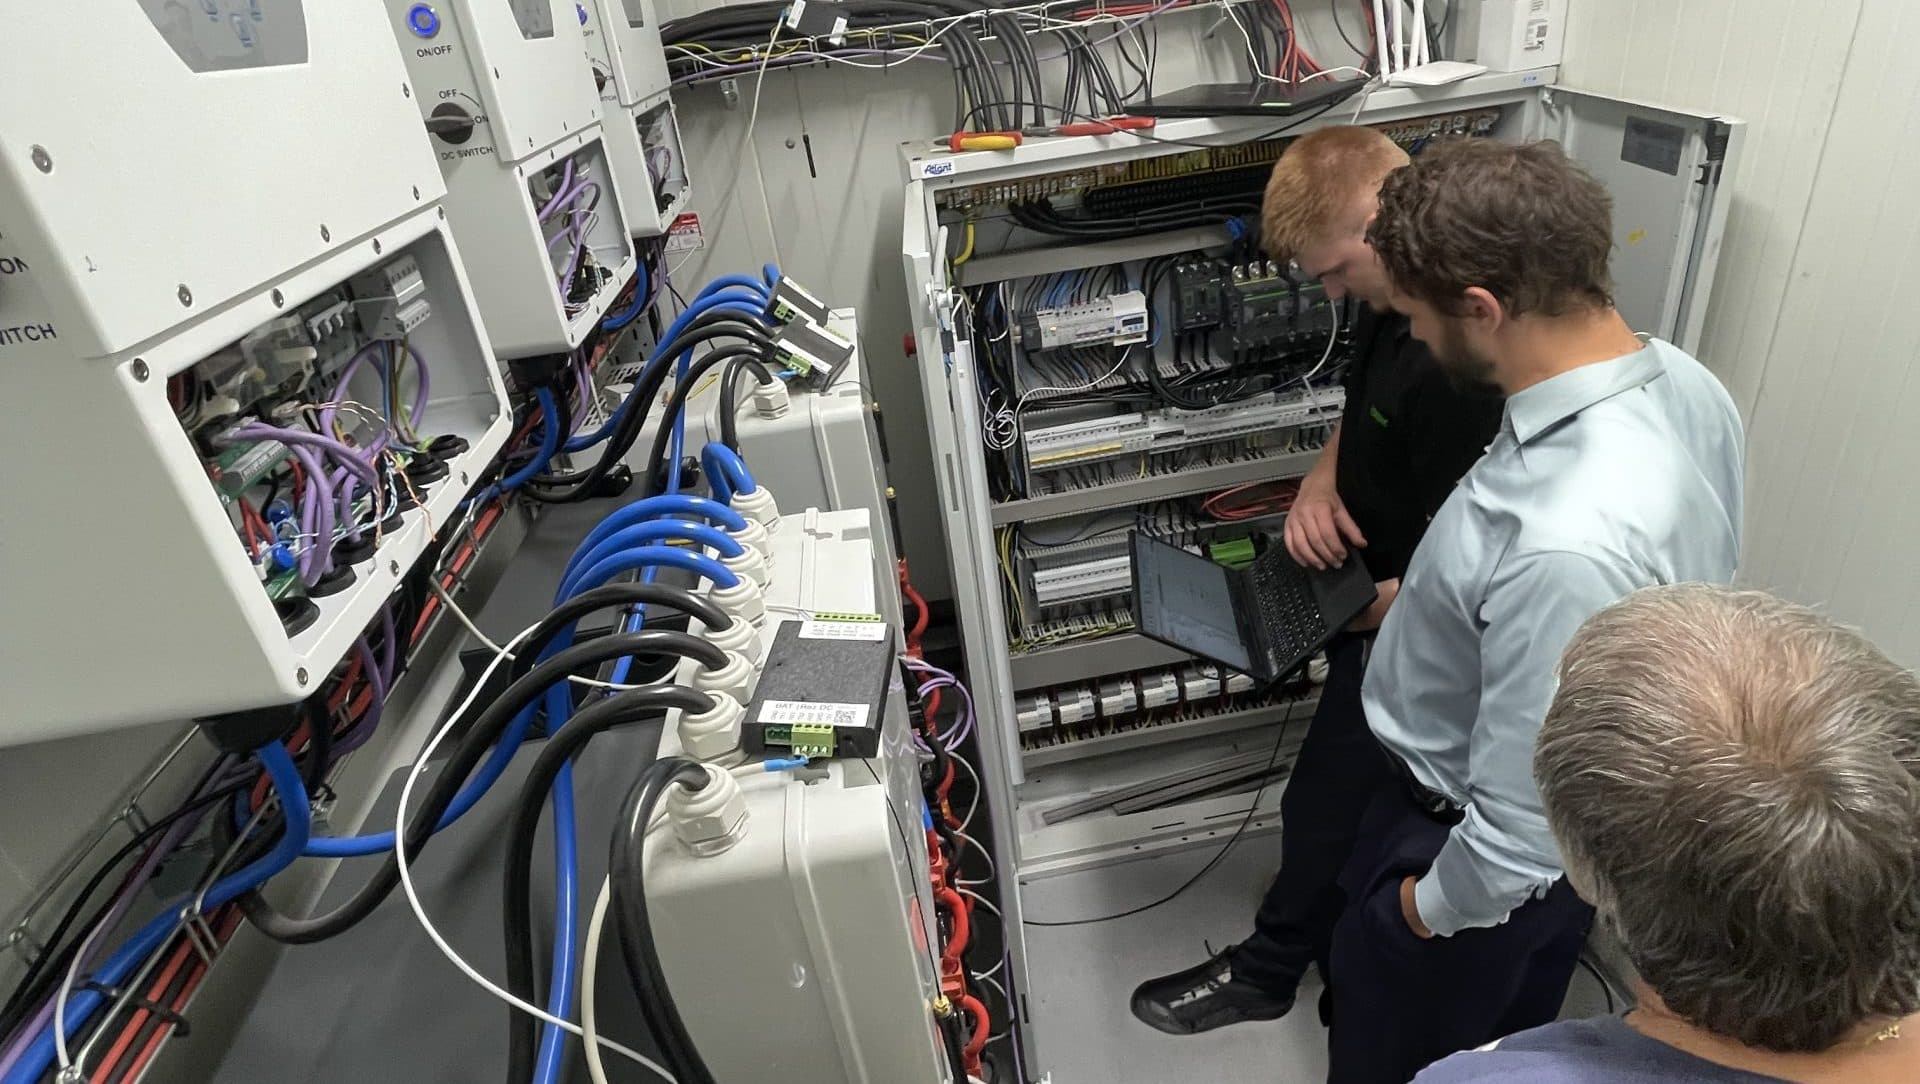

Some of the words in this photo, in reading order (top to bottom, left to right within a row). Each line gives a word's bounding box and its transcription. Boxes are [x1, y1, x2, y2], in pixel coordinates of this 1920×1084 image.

[417, 44, 453, 57] ON/OFF
[439, 88, 457, 99] OFF
[441, 152, 455, 160] DC
[457, 145, 494, 159] SWITCH
[0, 322, 57, 345] ITCH
